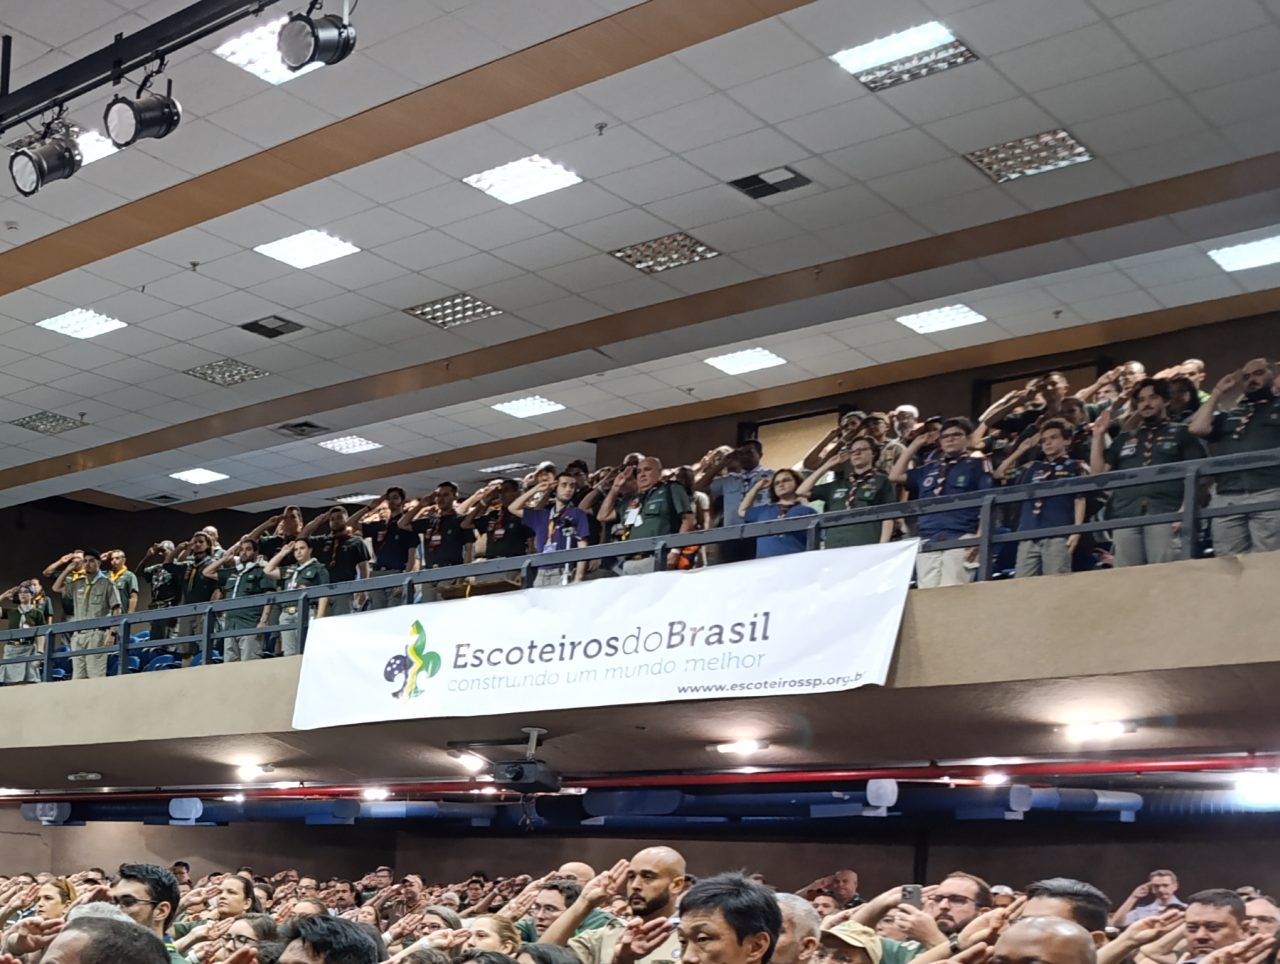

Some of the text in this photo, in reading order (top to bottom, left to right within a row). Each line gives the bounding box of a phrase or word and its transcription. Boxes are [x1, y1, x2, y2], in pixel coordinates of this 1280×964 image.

[453, 611, 770, 669] EscoteirosdoBrasil
[566, 668, 597, 684] um
[604, 657, 677, 680] mundo
[684, 651, 766, 673] melhor
